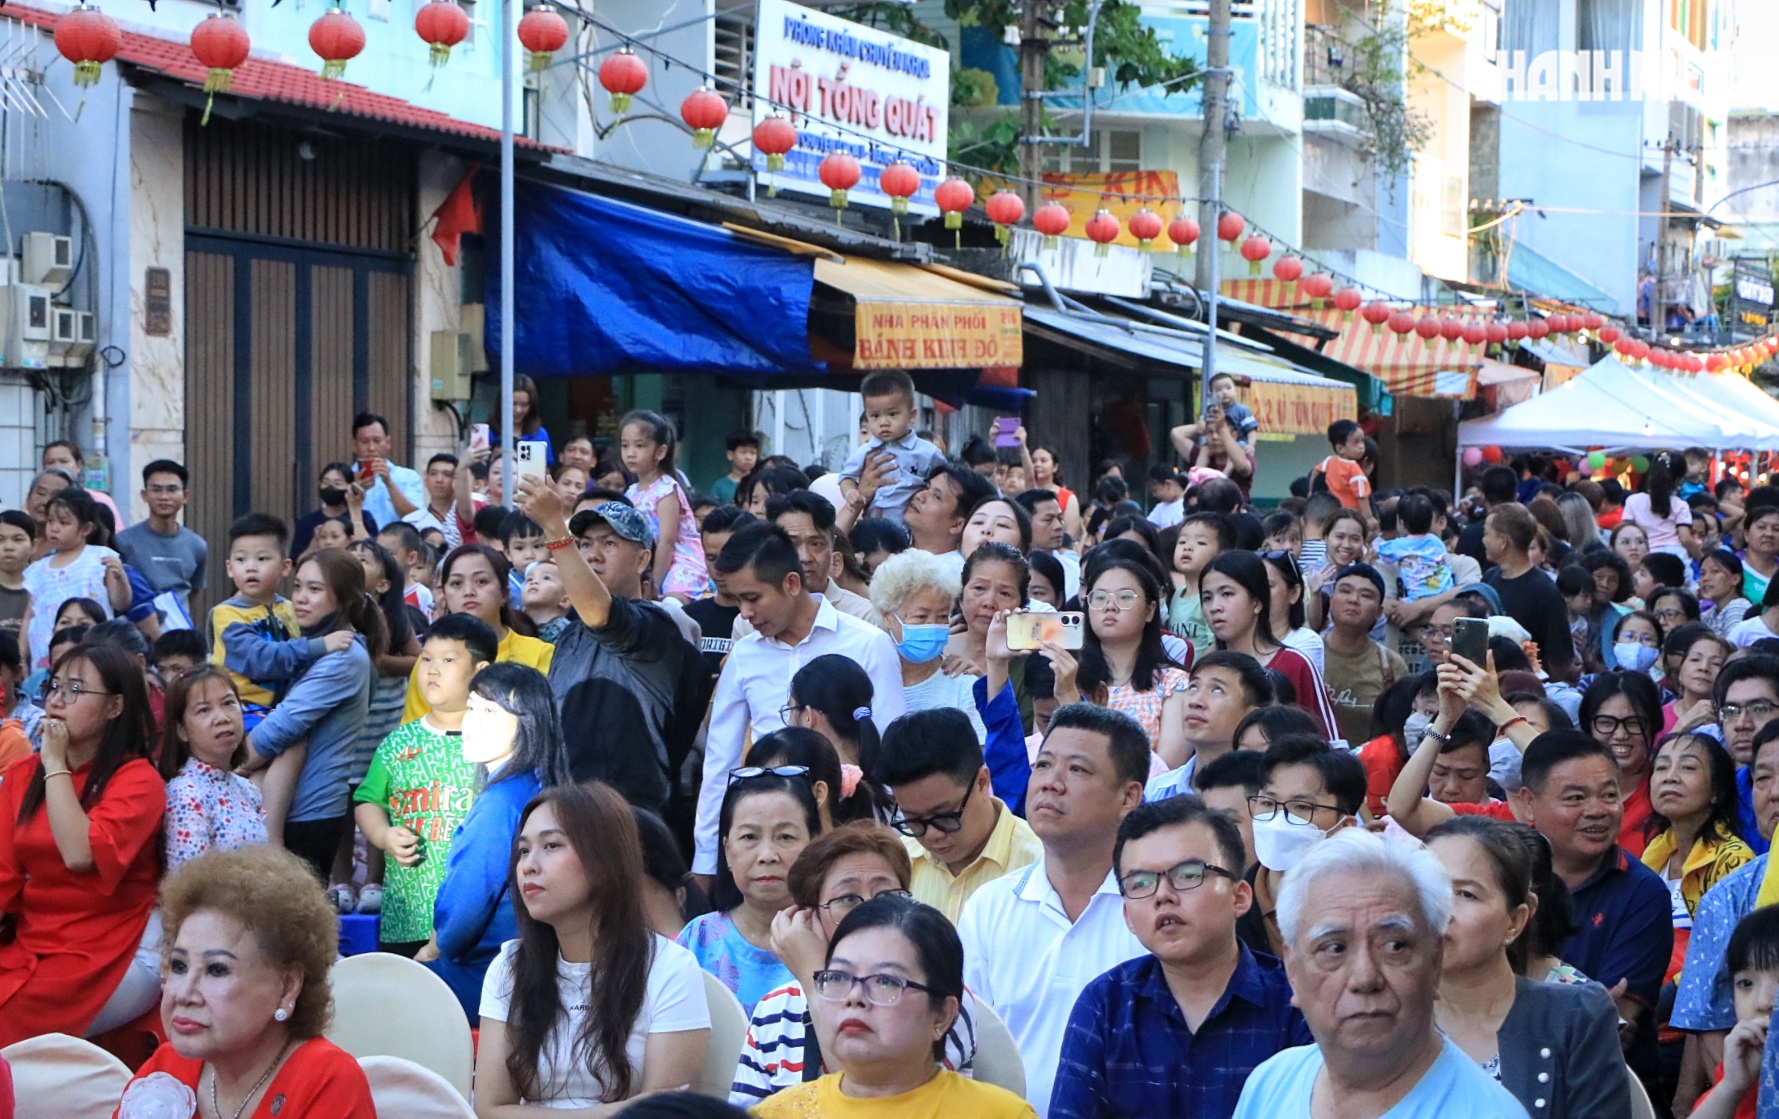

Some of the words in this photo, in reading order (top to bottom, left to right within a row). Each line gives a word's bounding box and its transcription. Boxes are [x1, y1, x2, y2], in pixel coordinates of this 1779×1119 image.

[769, 59, 813, 123] NỘI
[818, 61, 880, 129] TỔNG
[884, 93, 941, 143] QUÁT
[858, 333, 917, 360] BÁNH
[974, 334, 998, 359] ĐÔ
